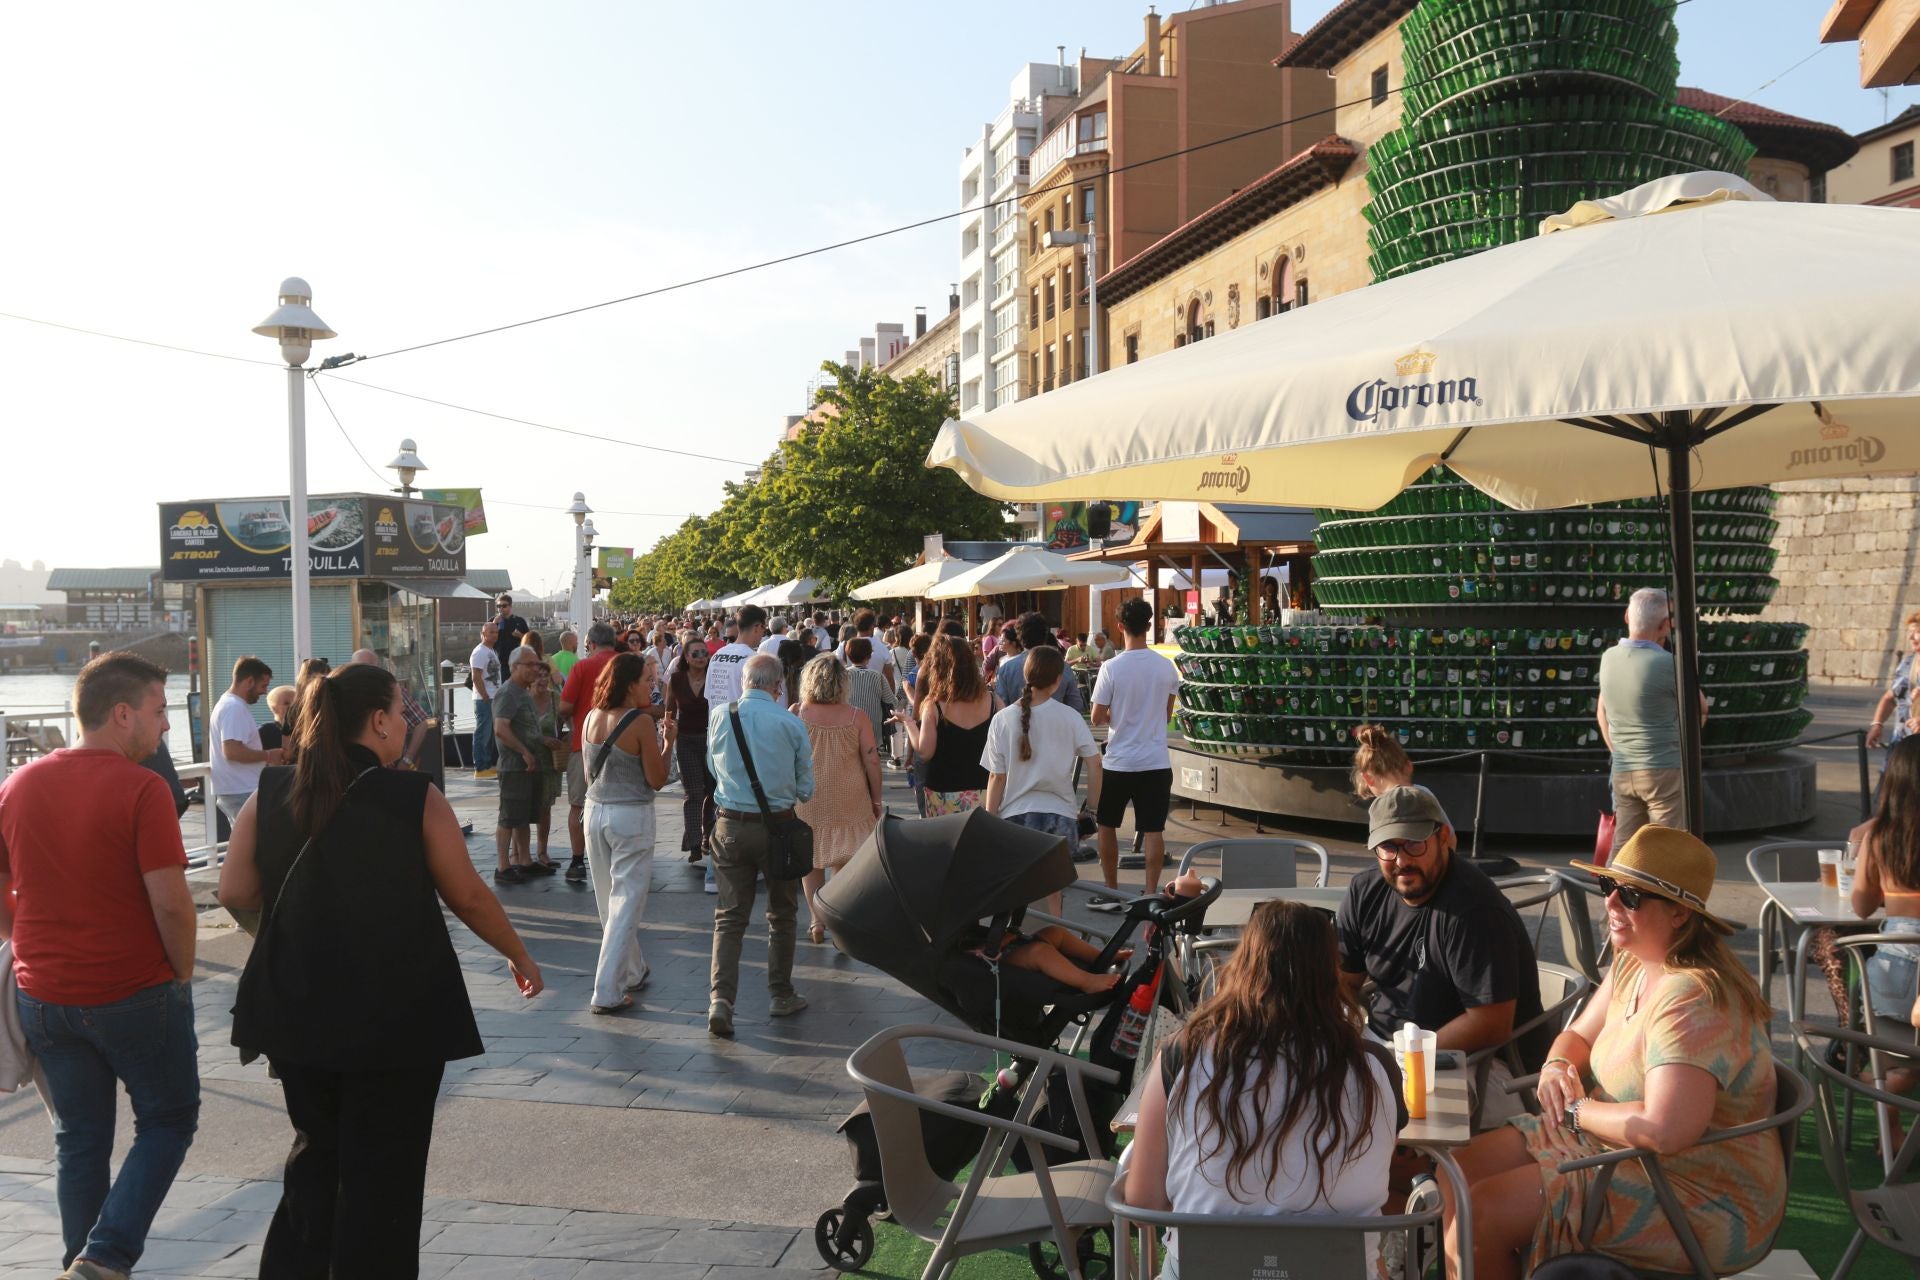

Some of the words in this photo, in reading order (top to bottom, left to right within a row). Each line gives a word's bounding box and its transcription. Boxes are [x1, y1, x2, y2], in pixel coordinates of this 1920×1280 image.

[1346, 377, 1478, 424] Corona
[169, 550, 220, 560] JETBOAT
[282, 555, 360, 571] TUILLA
[428, 559, 459, 571] TAQUILLA
[1253, 1269, 1289, 1278] CERVEZAS
